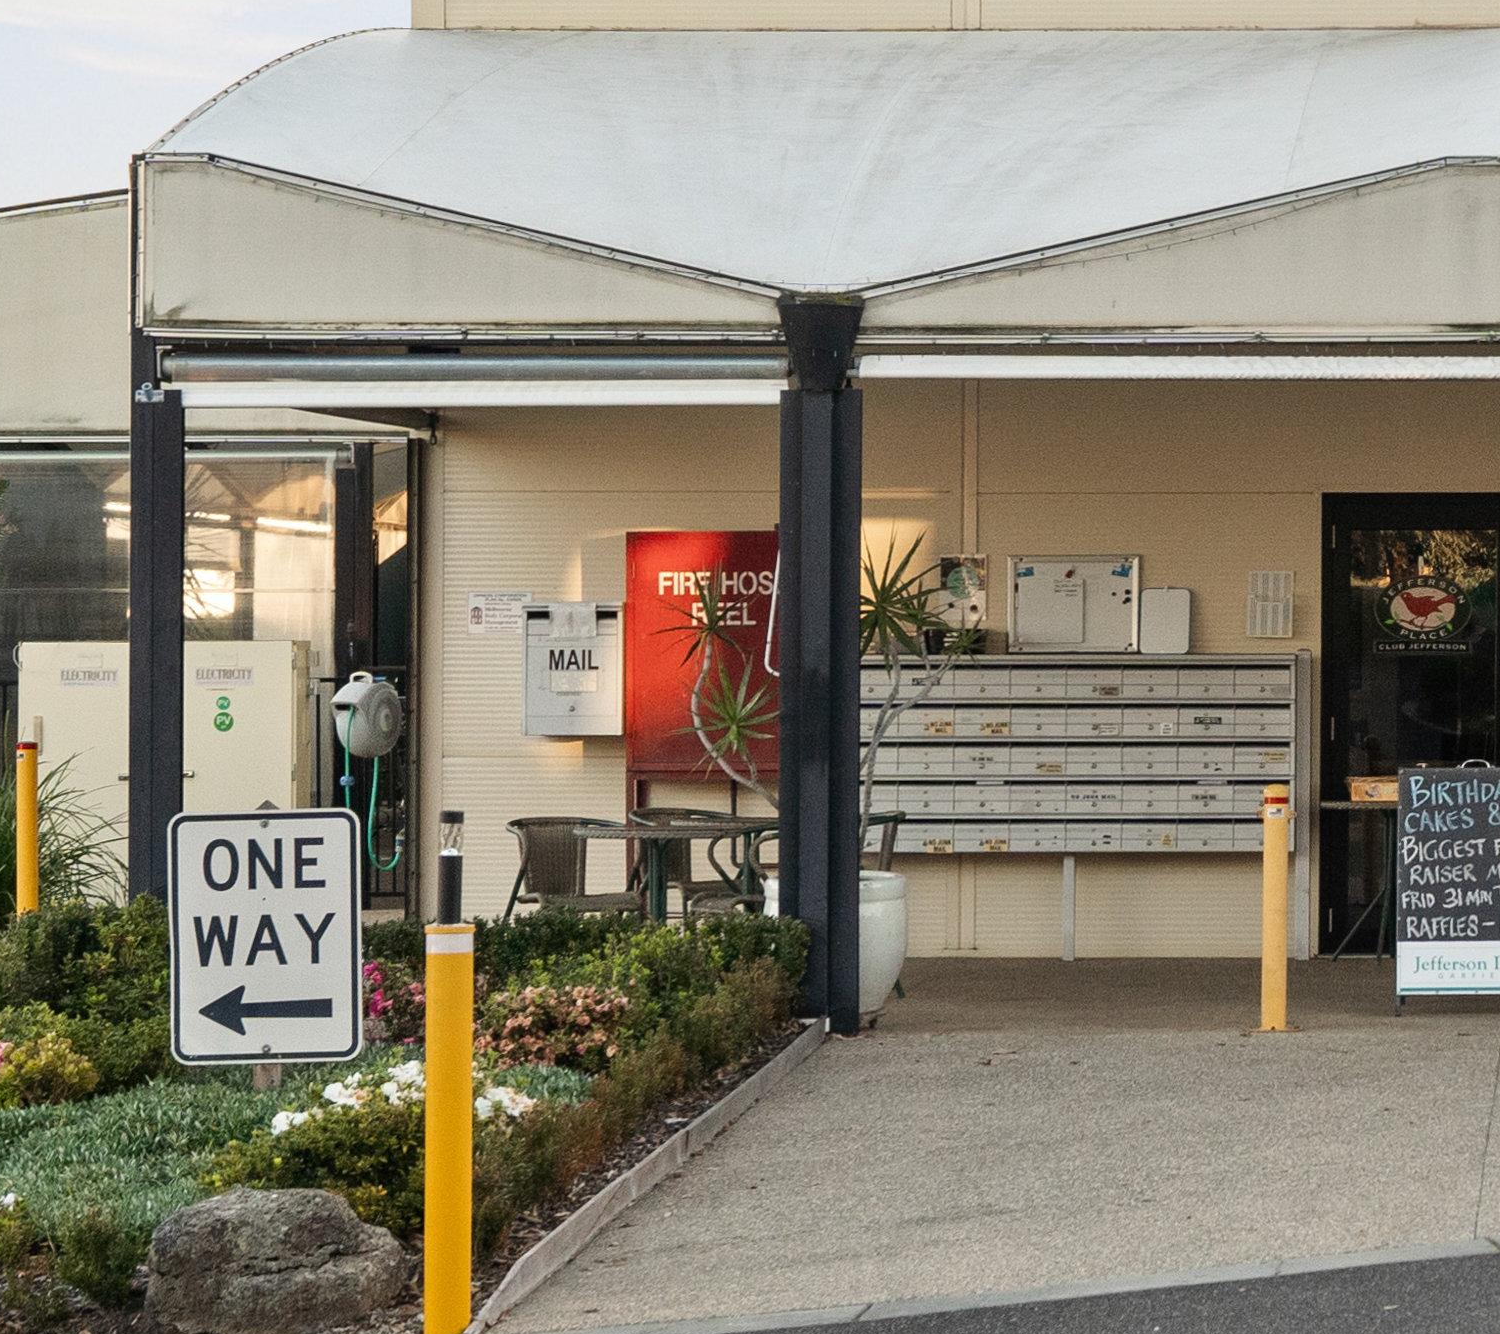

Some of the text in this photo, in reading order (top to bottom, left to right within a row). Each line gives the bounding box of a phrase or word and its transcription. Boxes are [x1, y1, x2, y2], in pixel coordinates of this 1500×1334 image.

[721, 571, 779, 596] HOS
[1383, 579, 1466, 604] JEFFERSON
[1400, 629, 1447, 640] PLACE
[1378, 643, 1466, 651] CLUB JEFFERSON
[549, 650, 599, 670] MAIL
[60, 669, 118, 681] ELECTRICITY
[196, 668, 253, 680] ELECTRICITY
[216, 715, 232, 725] PV
[1404, 808, 1474, 833] CAKES
[1401, 835, 1486, 864] BIGGEST
[203, 837, 326, 892] ONE
[1410, 863, 1477, 885] RAISER
[1401, 889, 1435, 910] FRID
[193, 913, 336, 967] WAY
[1413, 955, 1487, 973] Jefferson
